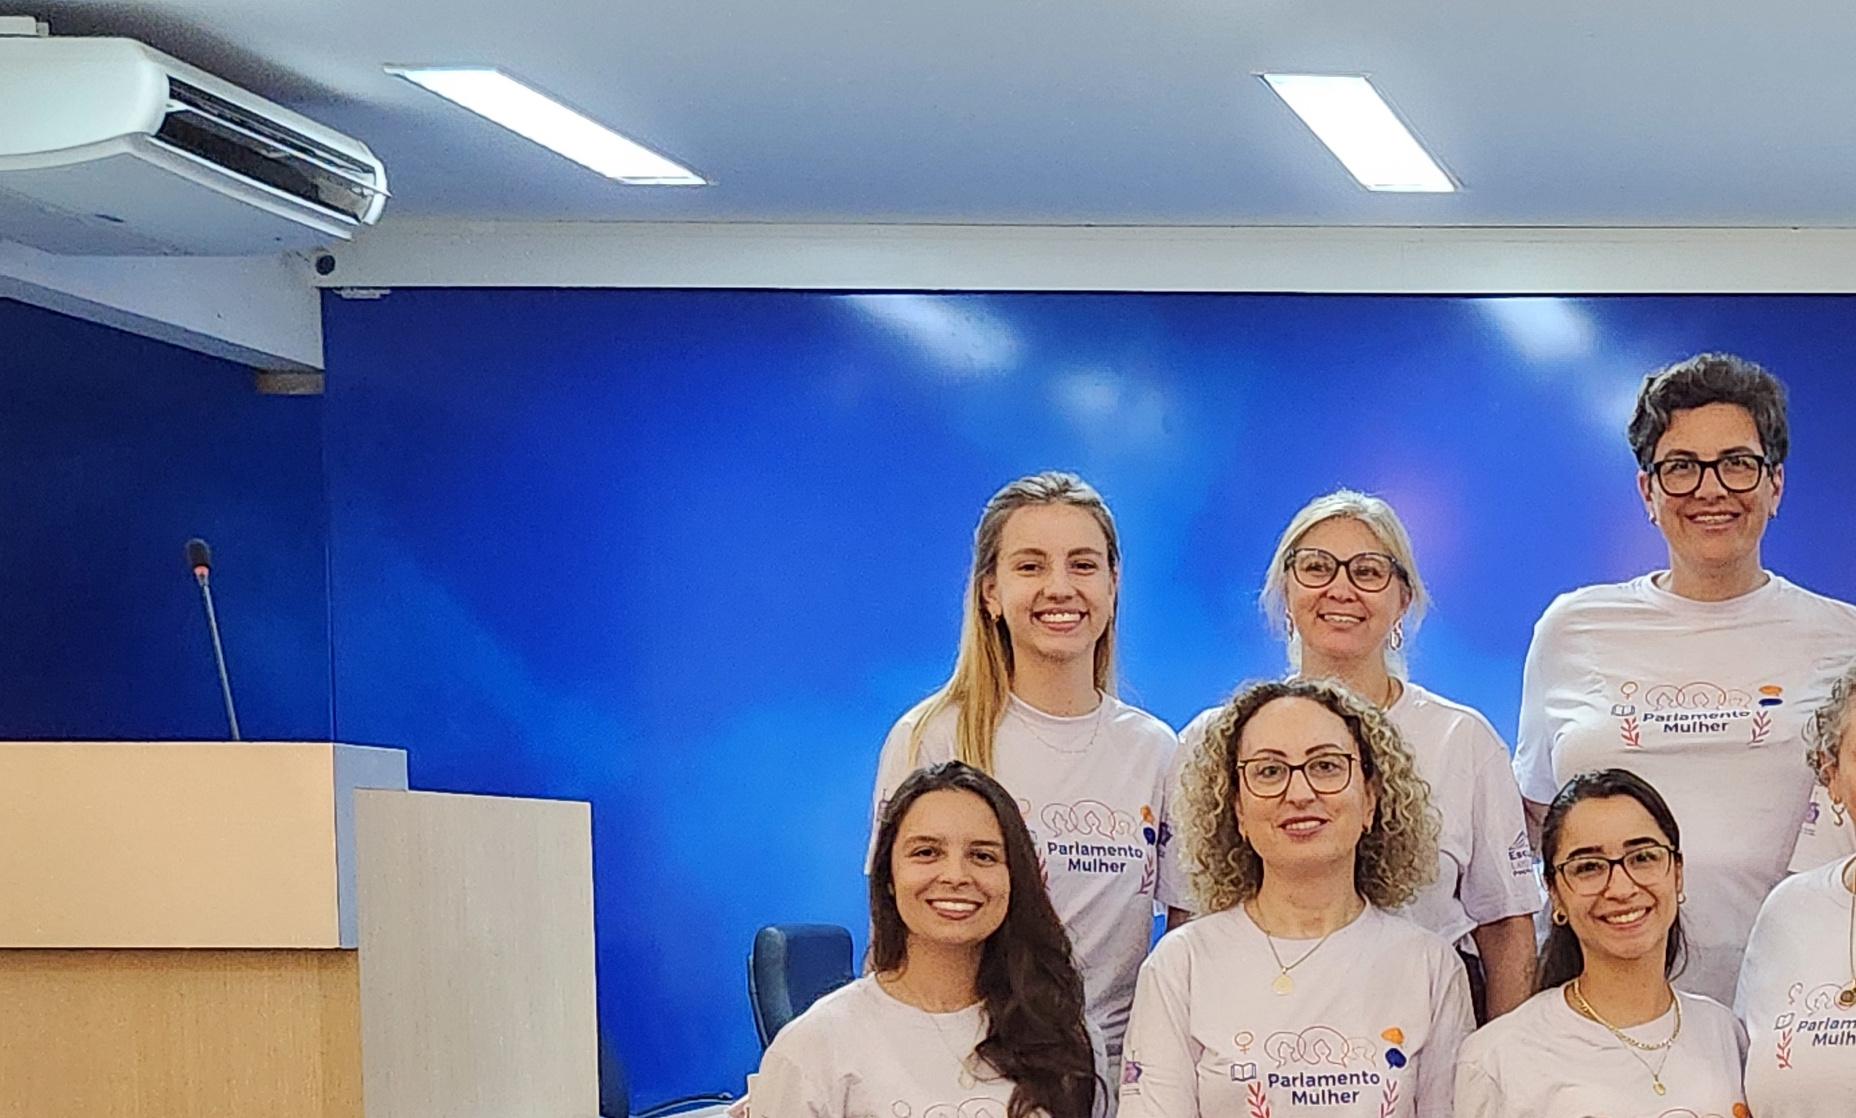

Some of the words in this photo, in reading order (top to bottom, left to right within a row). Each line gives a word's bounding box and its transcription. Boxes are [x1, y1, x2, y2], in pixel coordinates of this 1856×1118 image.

[1643, 711, 1751, 722] Parlamento
[1663, 721, 1729, 733] Mulher
[1047, 841, 1143, 859] Parlamento
[1067, 858, 1127, 873] Mulher
[1267, 1070, 1380, 1088] Parlamento
[1291, 1089, 1360, 1106] Mulher
